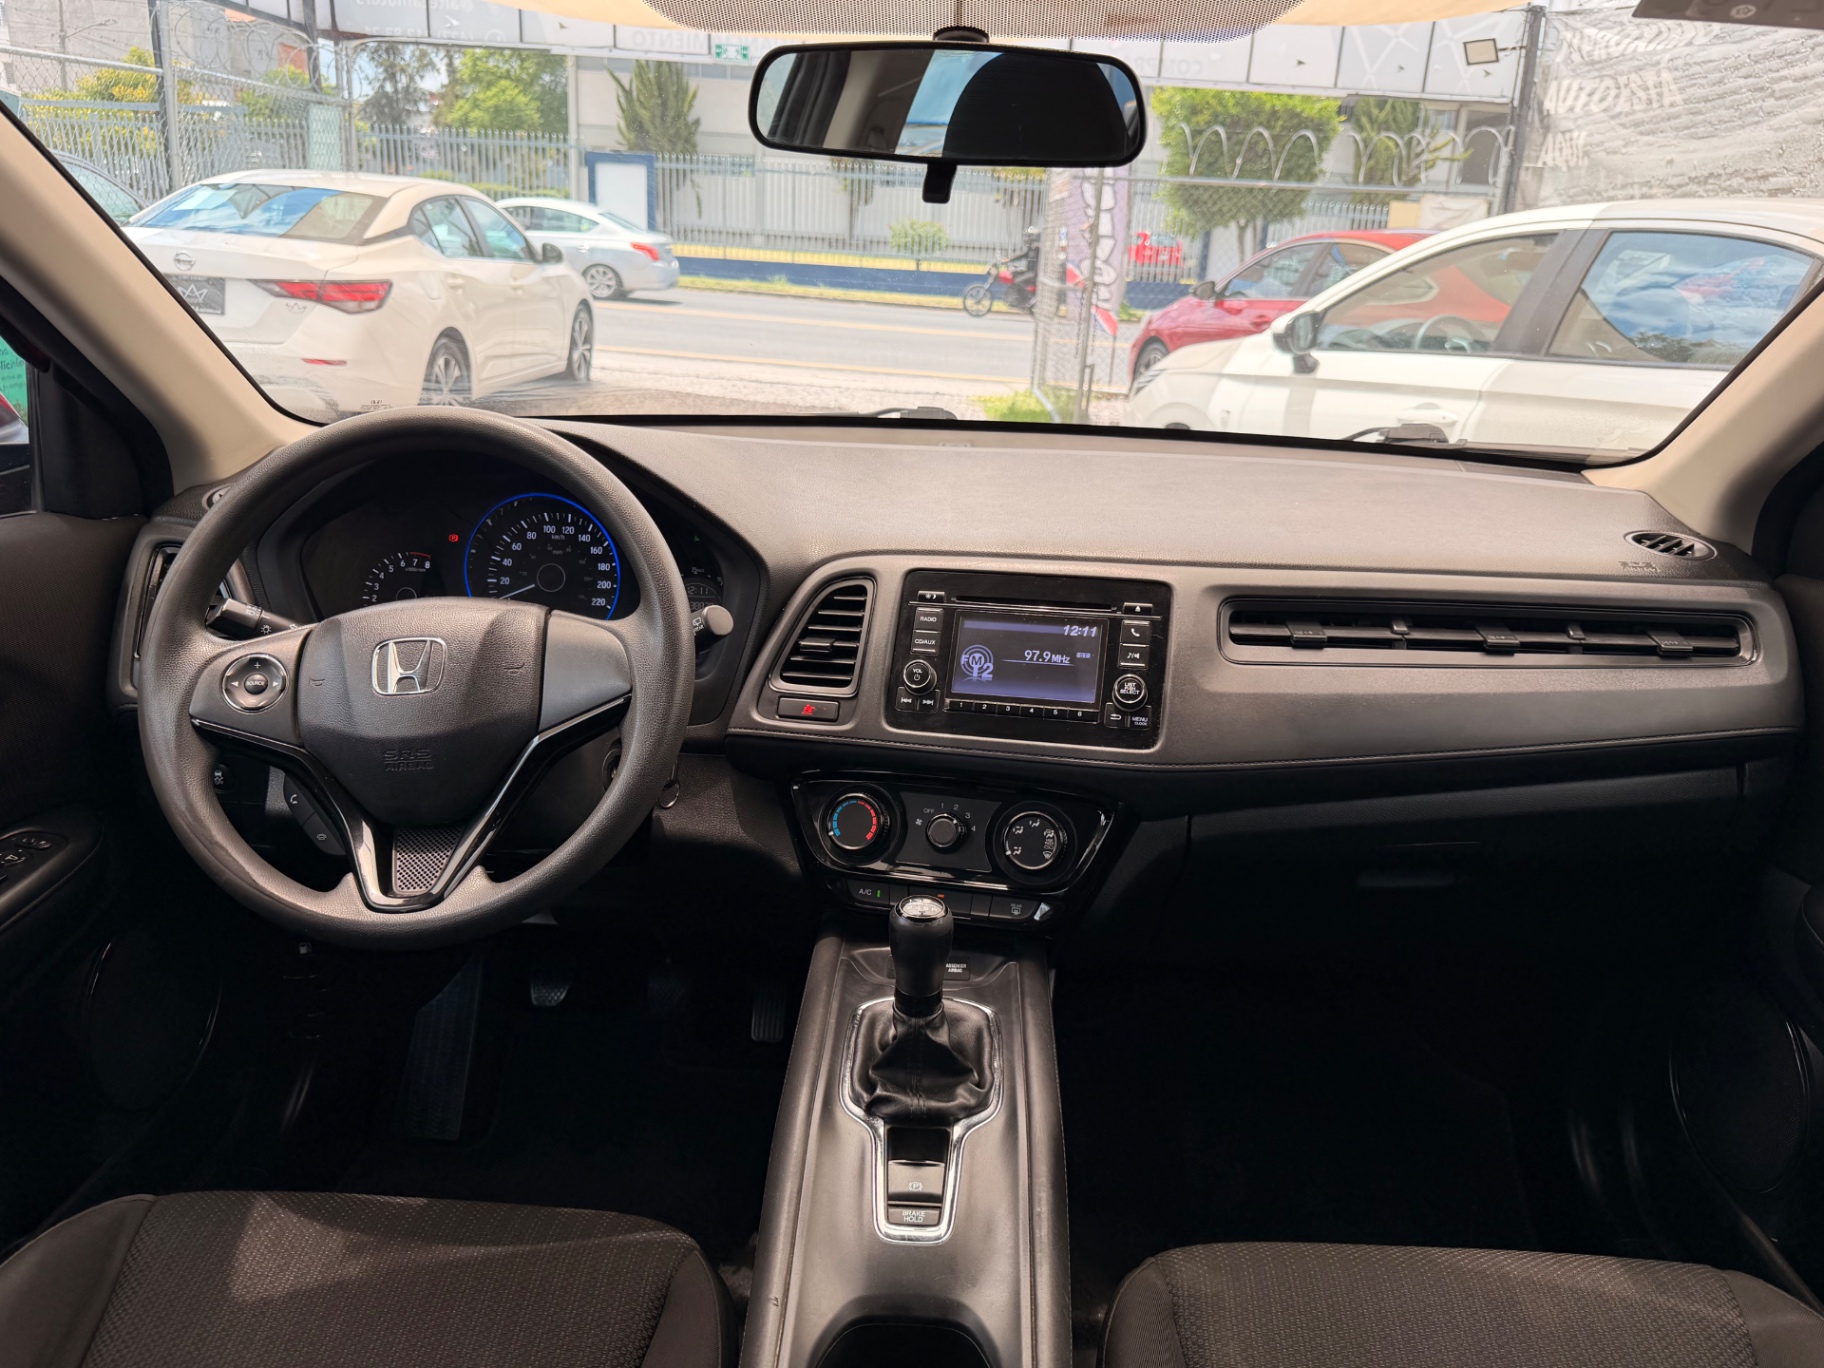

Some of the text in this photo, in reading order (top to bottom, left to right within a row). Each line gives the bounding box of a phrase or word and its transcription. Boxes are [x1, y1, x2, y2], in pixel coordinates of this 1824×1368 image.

[1543, 77, 1616, 115] AUTO
[543, 525, 556, 534] 100
[562, 526, 575, 534] 120
[526, 532, 537, 540] 80
[578, 534, 591, 543] 140
[512, 543, 522, 551] 60
[590, 547, 603, 555] 160
[413, 559, 418, 567] 7
[425, 561, 431, 569] 8
[502, 558, 513, 567] 40
[389, 565, 394, 573] 5
[598, 563, 611, 572] 180
[379, 572, 385, 580] 4
[500, 577, 510, 585] 20
[597, 581, 612, 589] 200
[374, 583, 380, 591] 3
[591, 598, 606, 606] 220
[1063, 625, 1098, 638] 12:11
[982, 663, 994, 681] 2
[384, 750, 433, 761] SRS
[385, 762, 434, 772] AIRBAG
[859, 888, 872, 896] A/C
[902, 1210, 926, 1218] BRAKE
